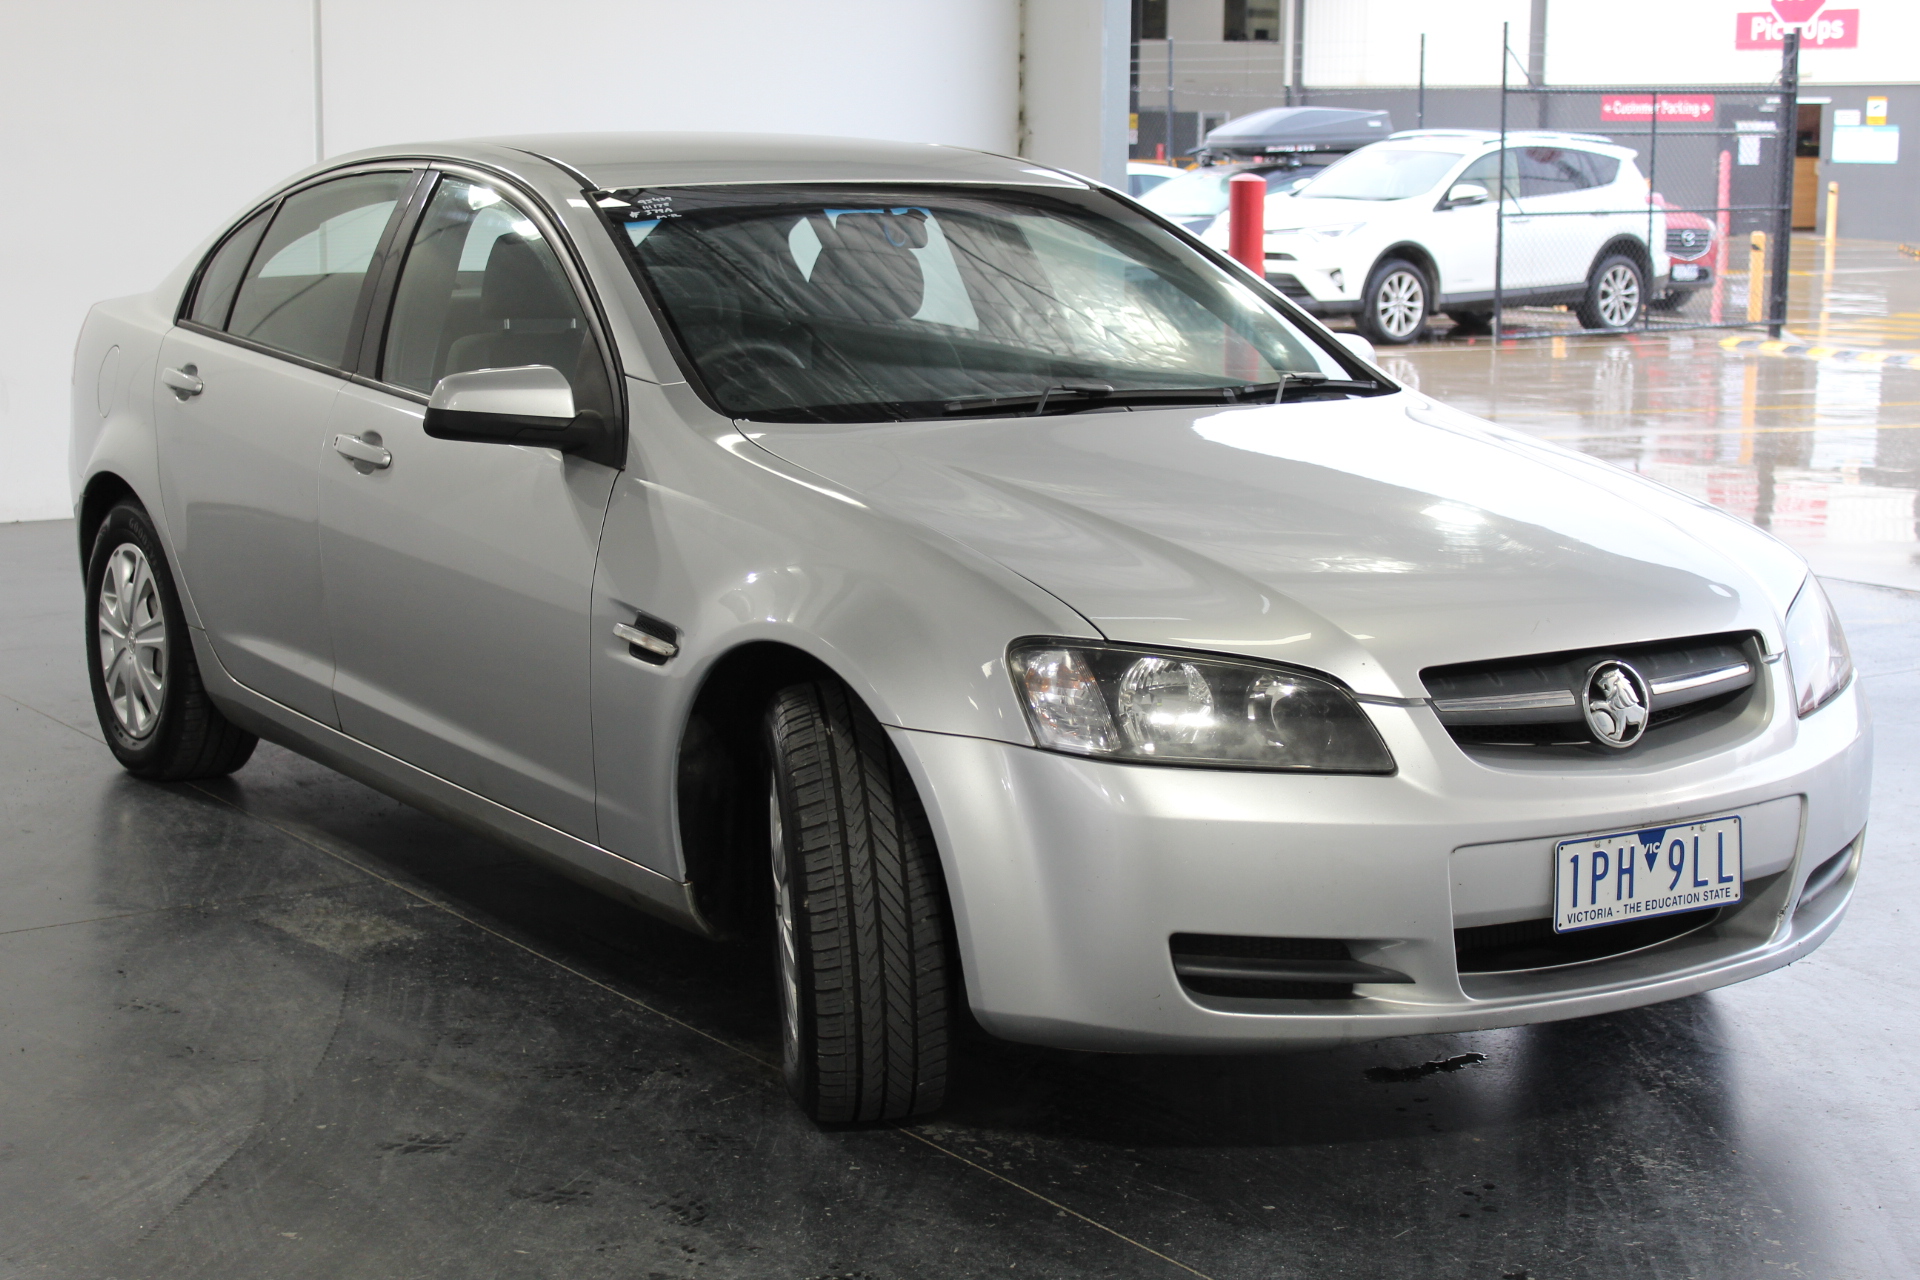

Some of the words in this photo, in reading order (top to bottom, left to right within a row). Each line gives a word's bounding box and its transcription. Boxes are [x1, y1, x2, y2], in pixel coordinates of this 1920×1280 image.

[1751, 16, 1797, 41] Pic
[1613, 100, 1660, 115] Customer
[1661, 100, 1700, 117] Parking
[1642, 841, 1661, 855] VIC
[1570, 844, 1636, 909] 1PH
[1668, 830, 1734, 892] 9LL
[1567, 907, 1614, 925] VICTORIA
[1623, 902, 1642, 915] THE
[1645, 892, 1701, 911] EDUCATION
[1703, 887, 1732, 902] STATE
